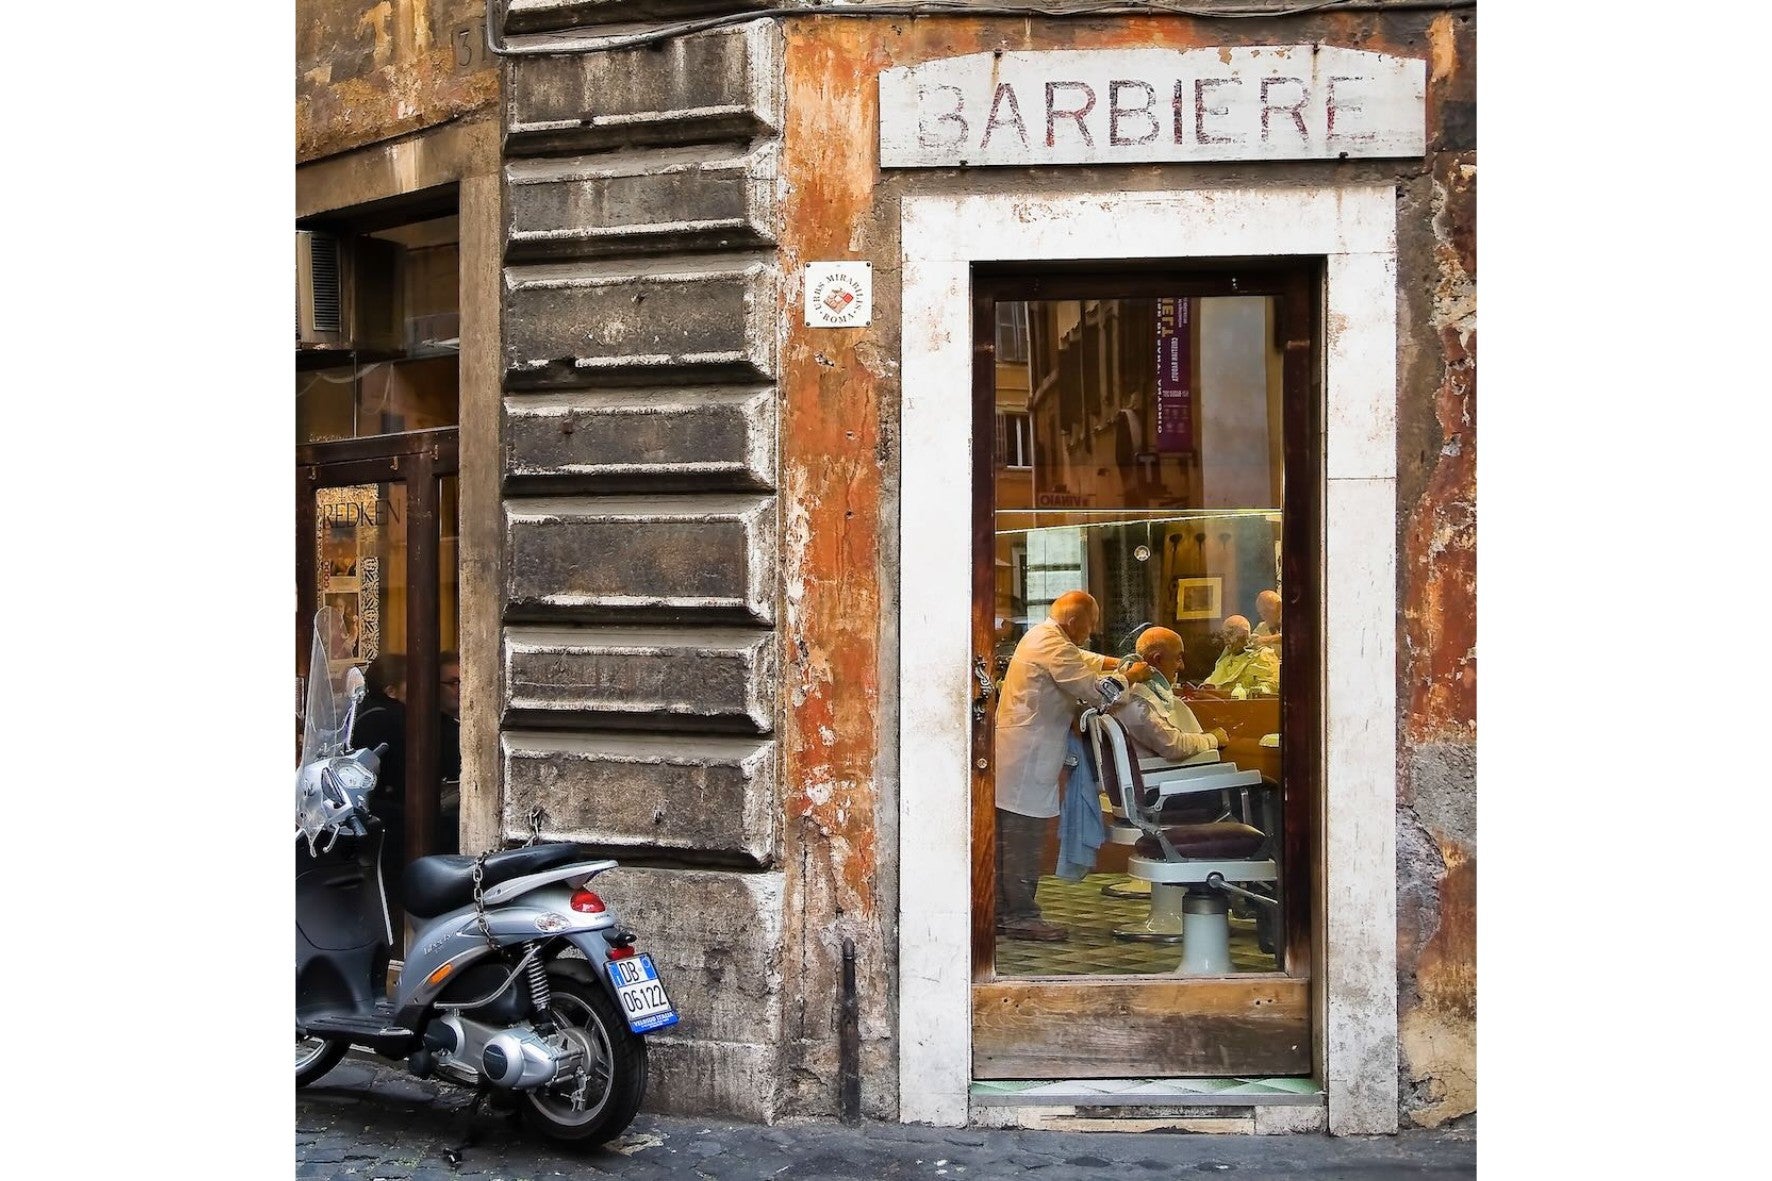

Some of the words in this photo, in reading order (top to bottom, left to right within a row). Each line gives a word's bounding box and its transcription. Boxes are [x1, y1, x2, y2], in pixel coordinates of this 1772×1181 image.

[918, 76, 1375, 150] BARBIERE
[813, 281, 825, 311] URBS
[822, 313, 854, 323] ROMA
[322, 497, 402, 529] REDKEN
[619, 961, 640, 983] DB
[623, 985, 667, 1012] 06122
